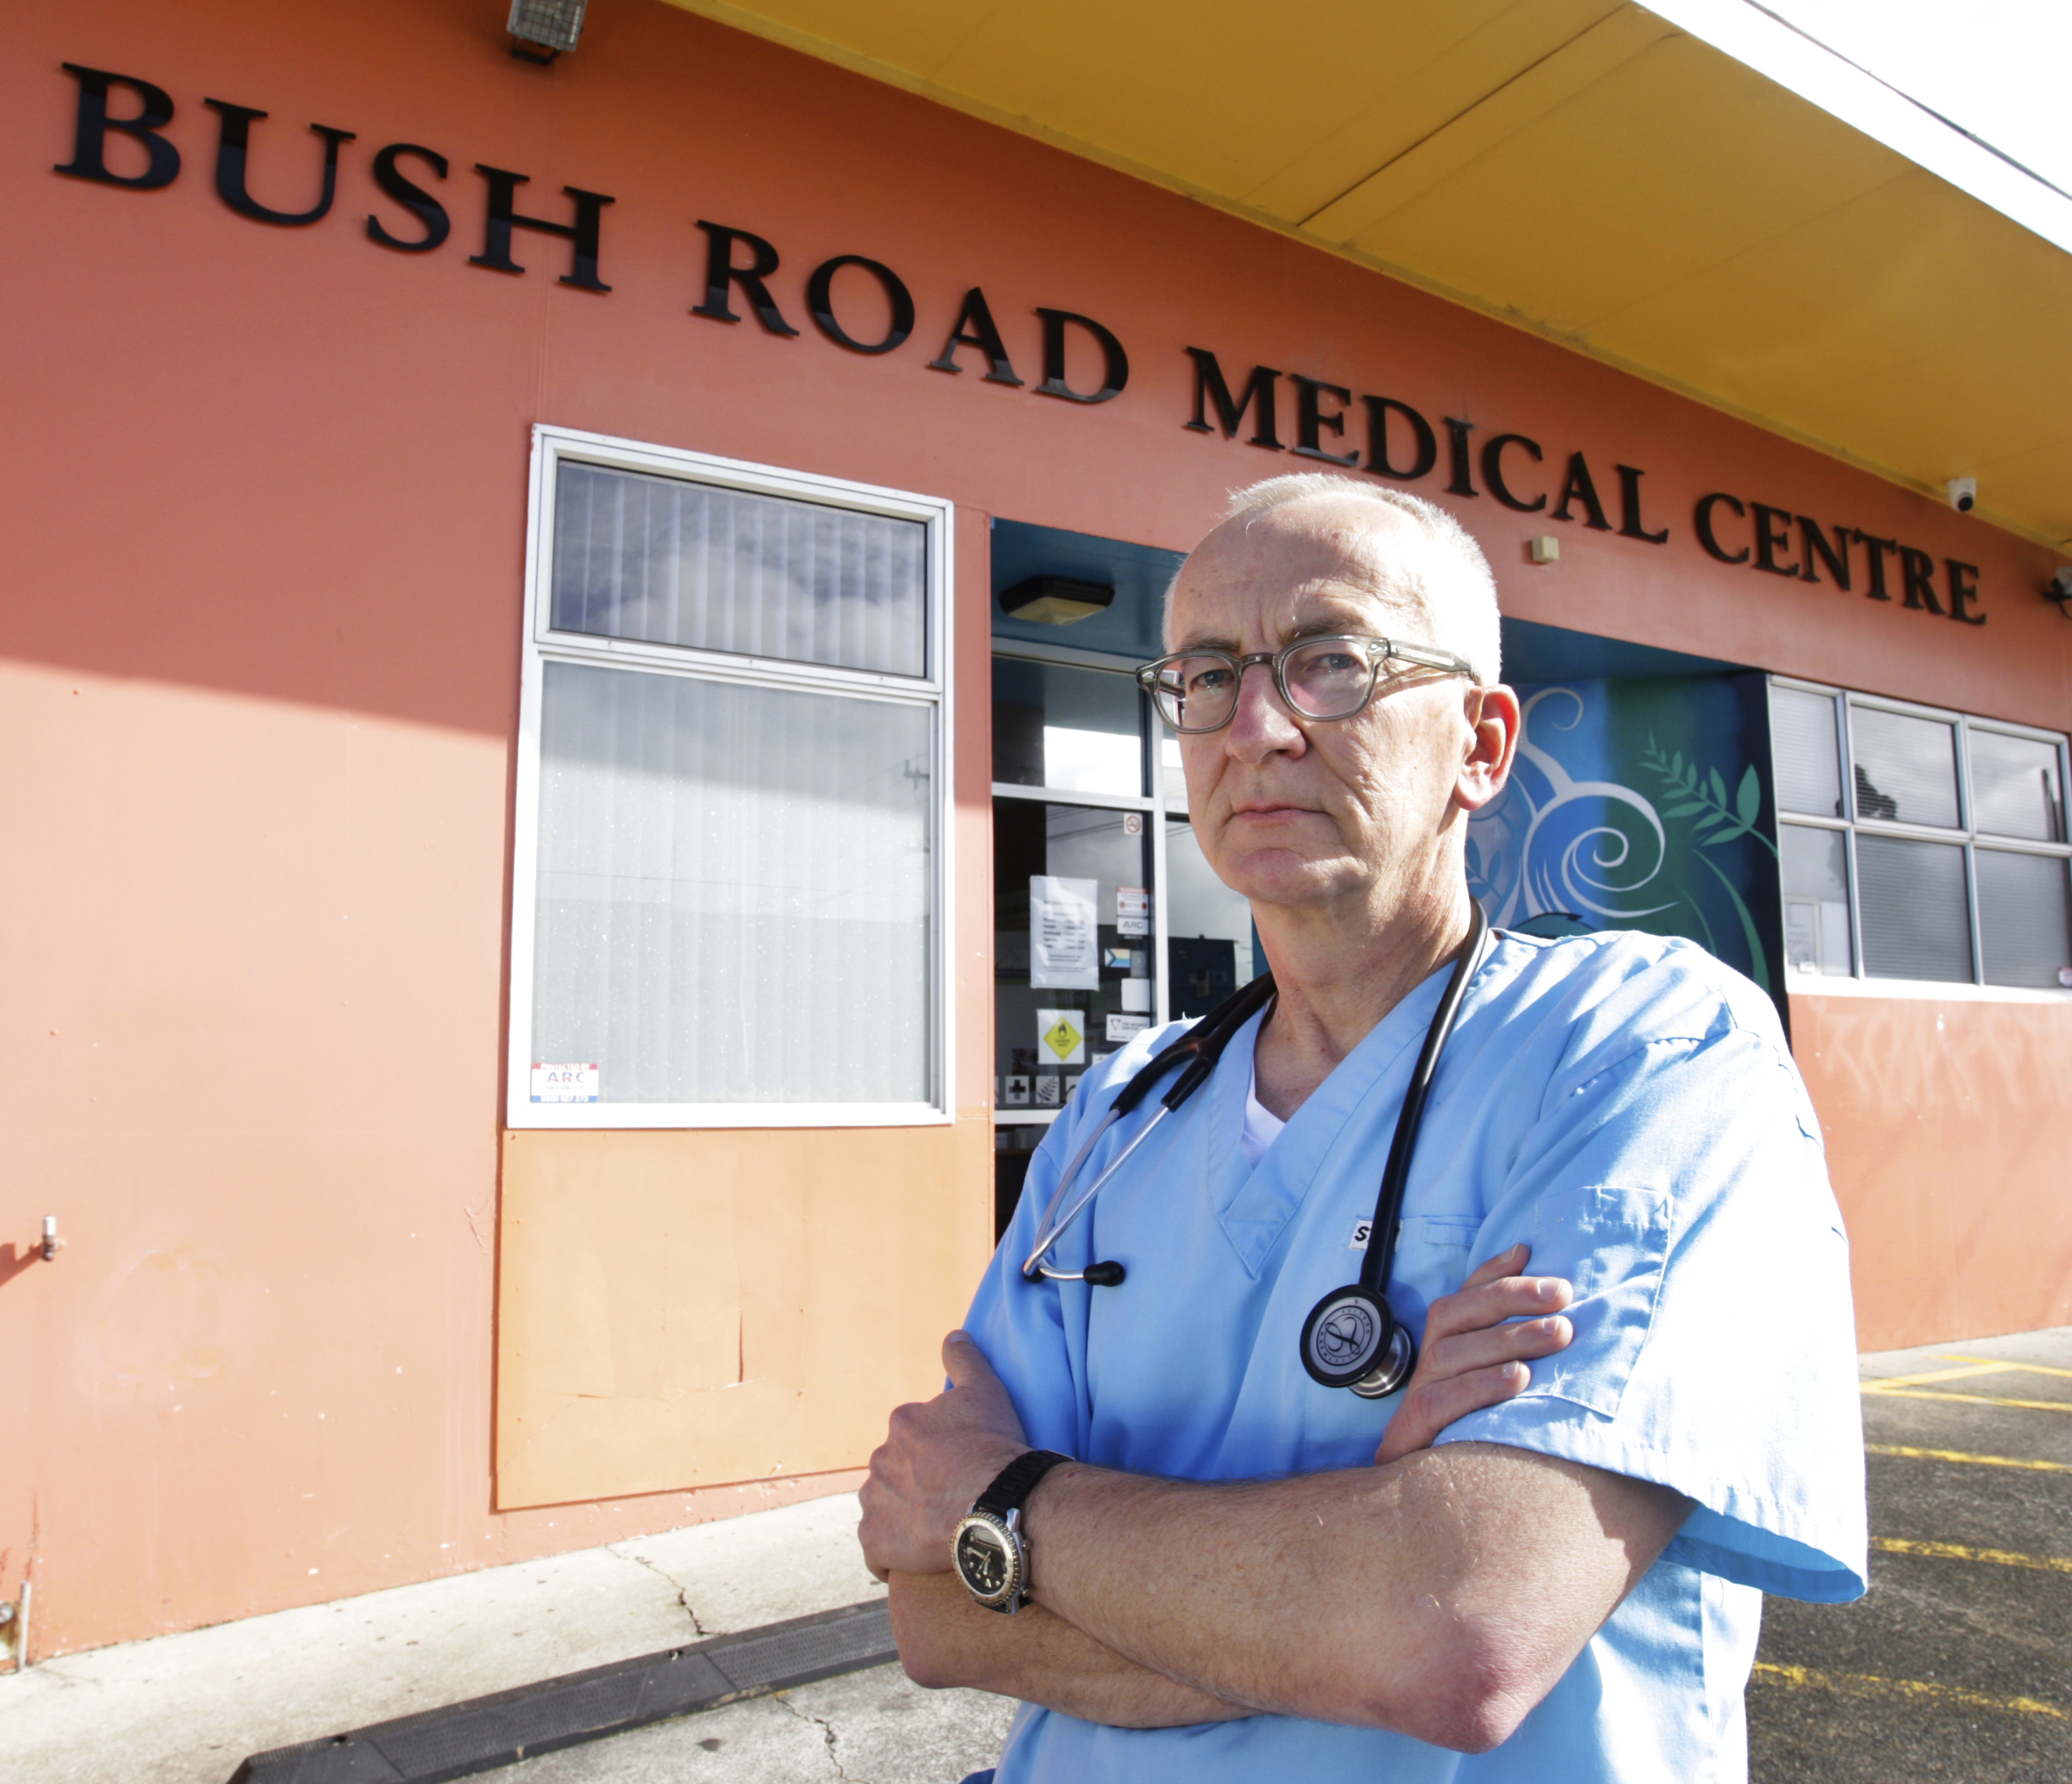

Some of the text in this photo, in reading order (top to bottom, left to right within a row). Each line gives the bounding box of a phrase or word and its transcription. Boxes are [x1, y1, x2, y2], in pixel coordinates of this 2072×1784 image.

[53, 62, 1987, 626] BUSH ROAD MEDICAL CENTRE
[1122, 921, 1144, 929] ARC
[547, 1071, 585, 1083] ARC
[1319, 1331, 1352, 1363] LITTMANN
